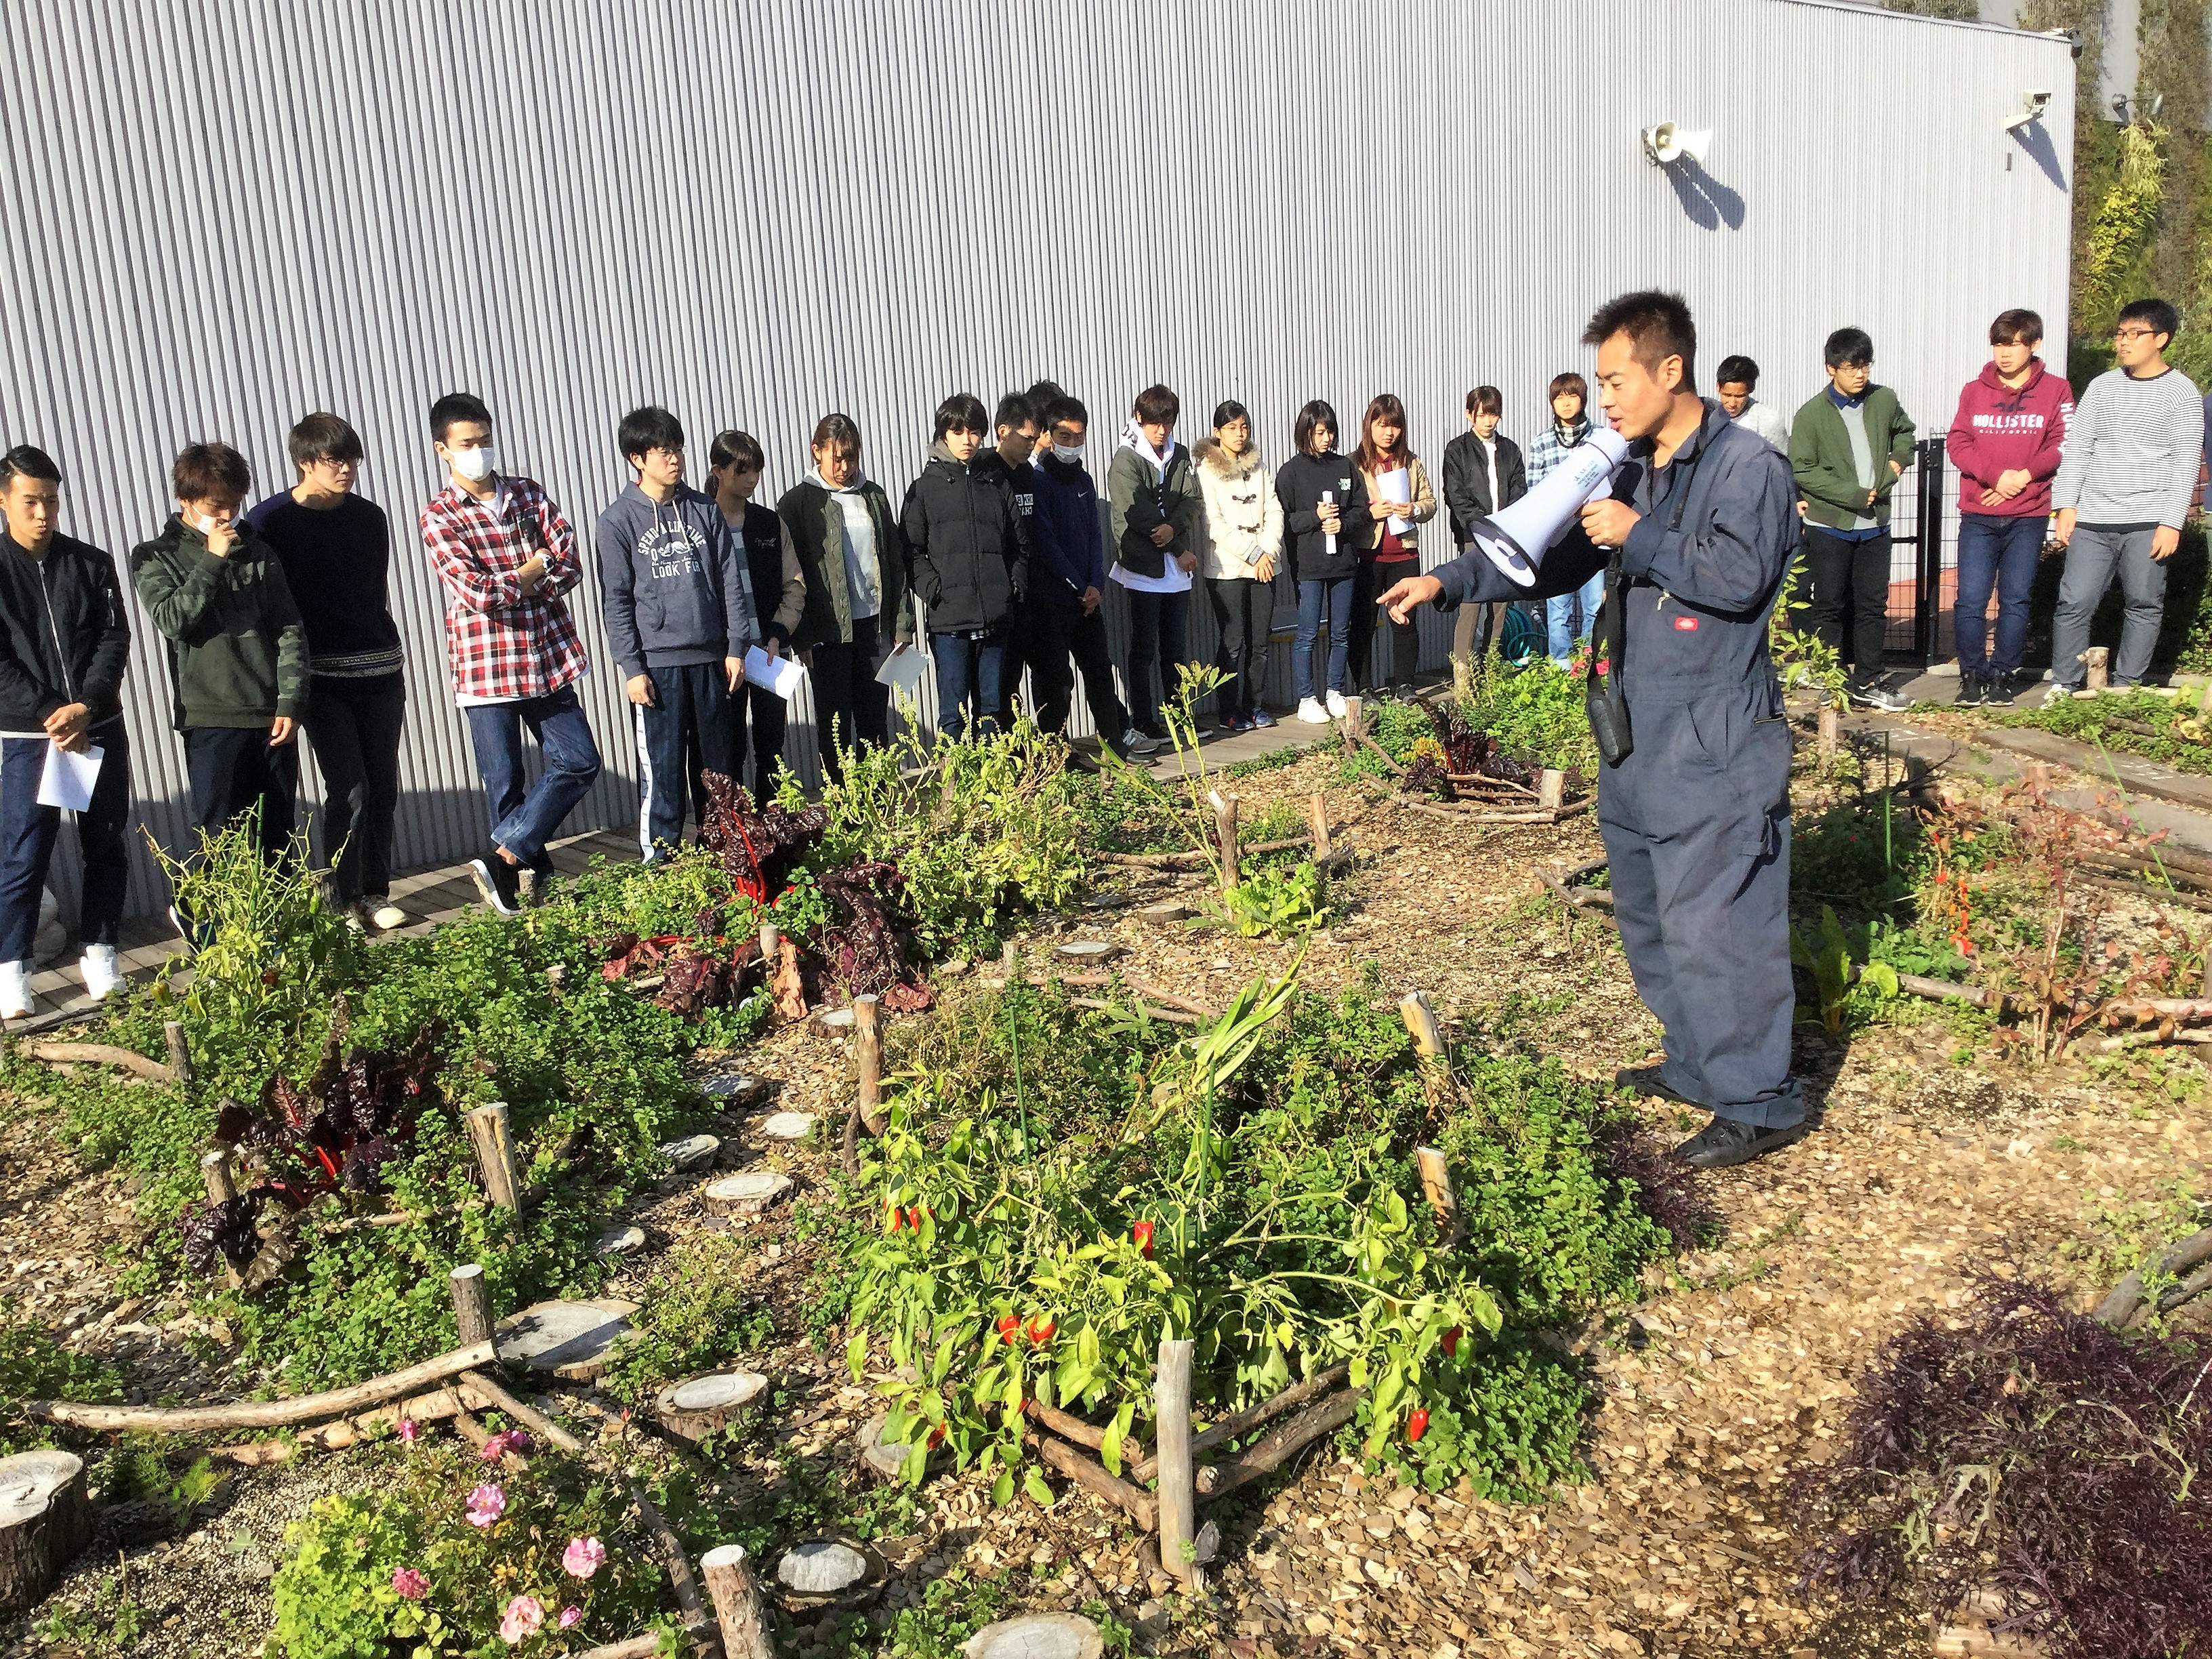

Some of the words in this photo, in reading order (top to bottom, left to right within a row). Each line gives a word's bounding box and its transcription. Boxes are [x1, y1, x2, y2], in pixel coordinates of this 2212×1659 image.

[1973, 414, 2044, 428] HOLLISTER
[638, 527, 660, 555] SPEND
[659, 523, 668, 535] A
[651, 564, 680, 579] LOOK
